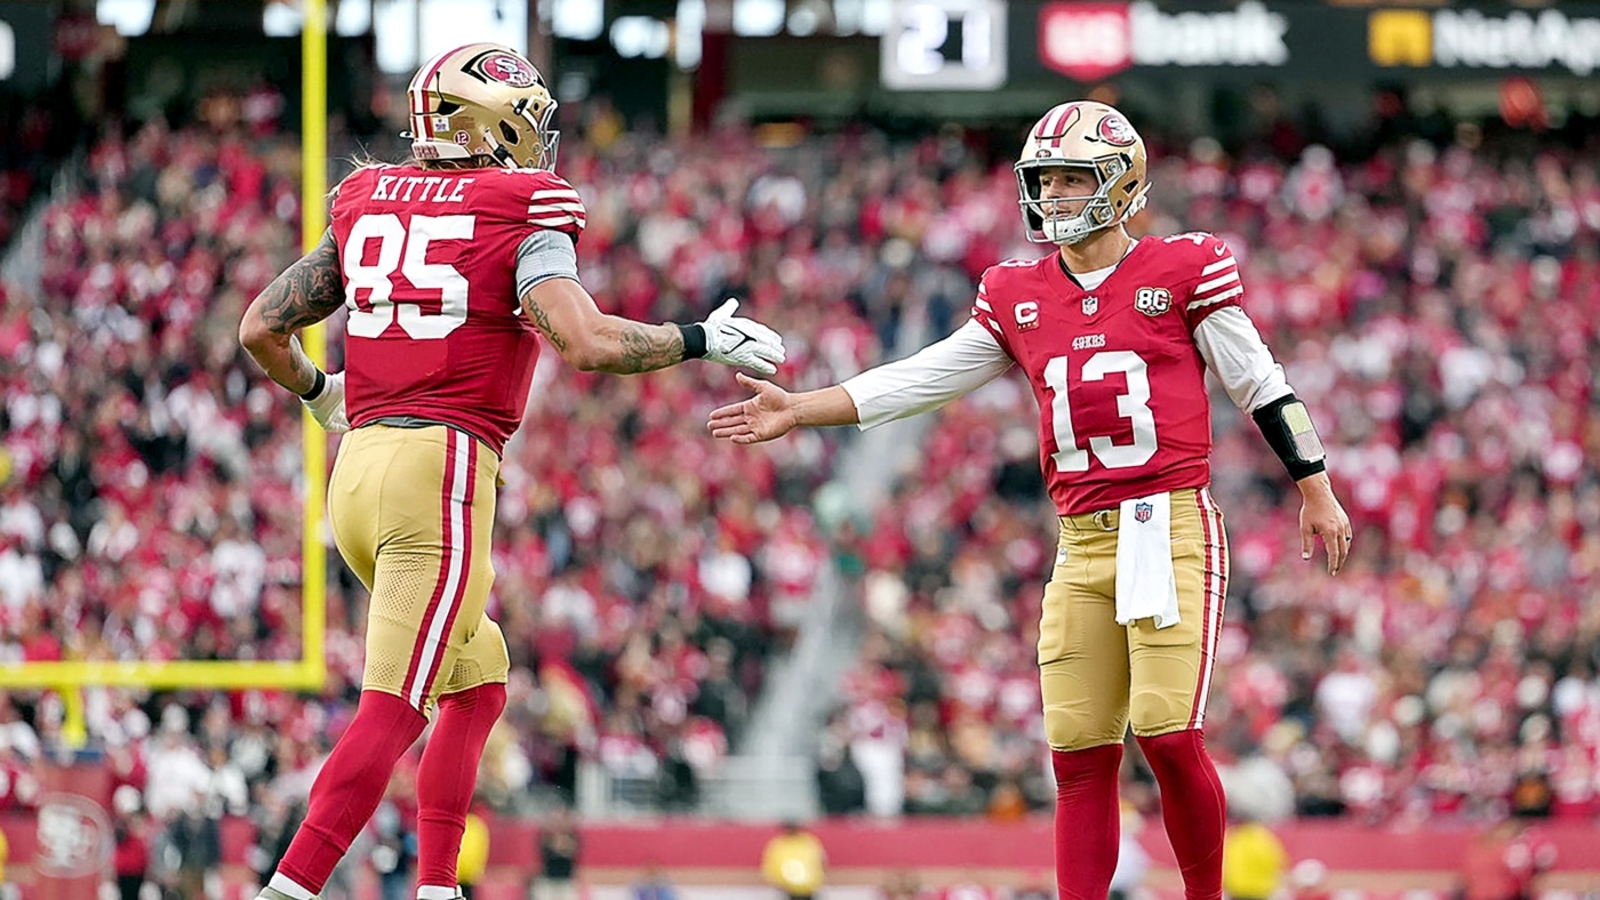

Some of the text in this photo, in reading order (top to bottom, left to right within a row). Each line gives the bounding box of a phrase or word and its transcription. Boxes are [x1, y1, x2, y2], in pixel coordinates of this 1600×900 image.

[897, 4, 990, 75] 21
[456, 133, 468, 144] 12
[370, 174, 476, 202] KITTLE
[343, 213, 476, 339] 85
[1014, 300, 1039, 324] C
[1071, 333, 1106, 351] 49ERS
[1044, 350, 1158, 472] 13
